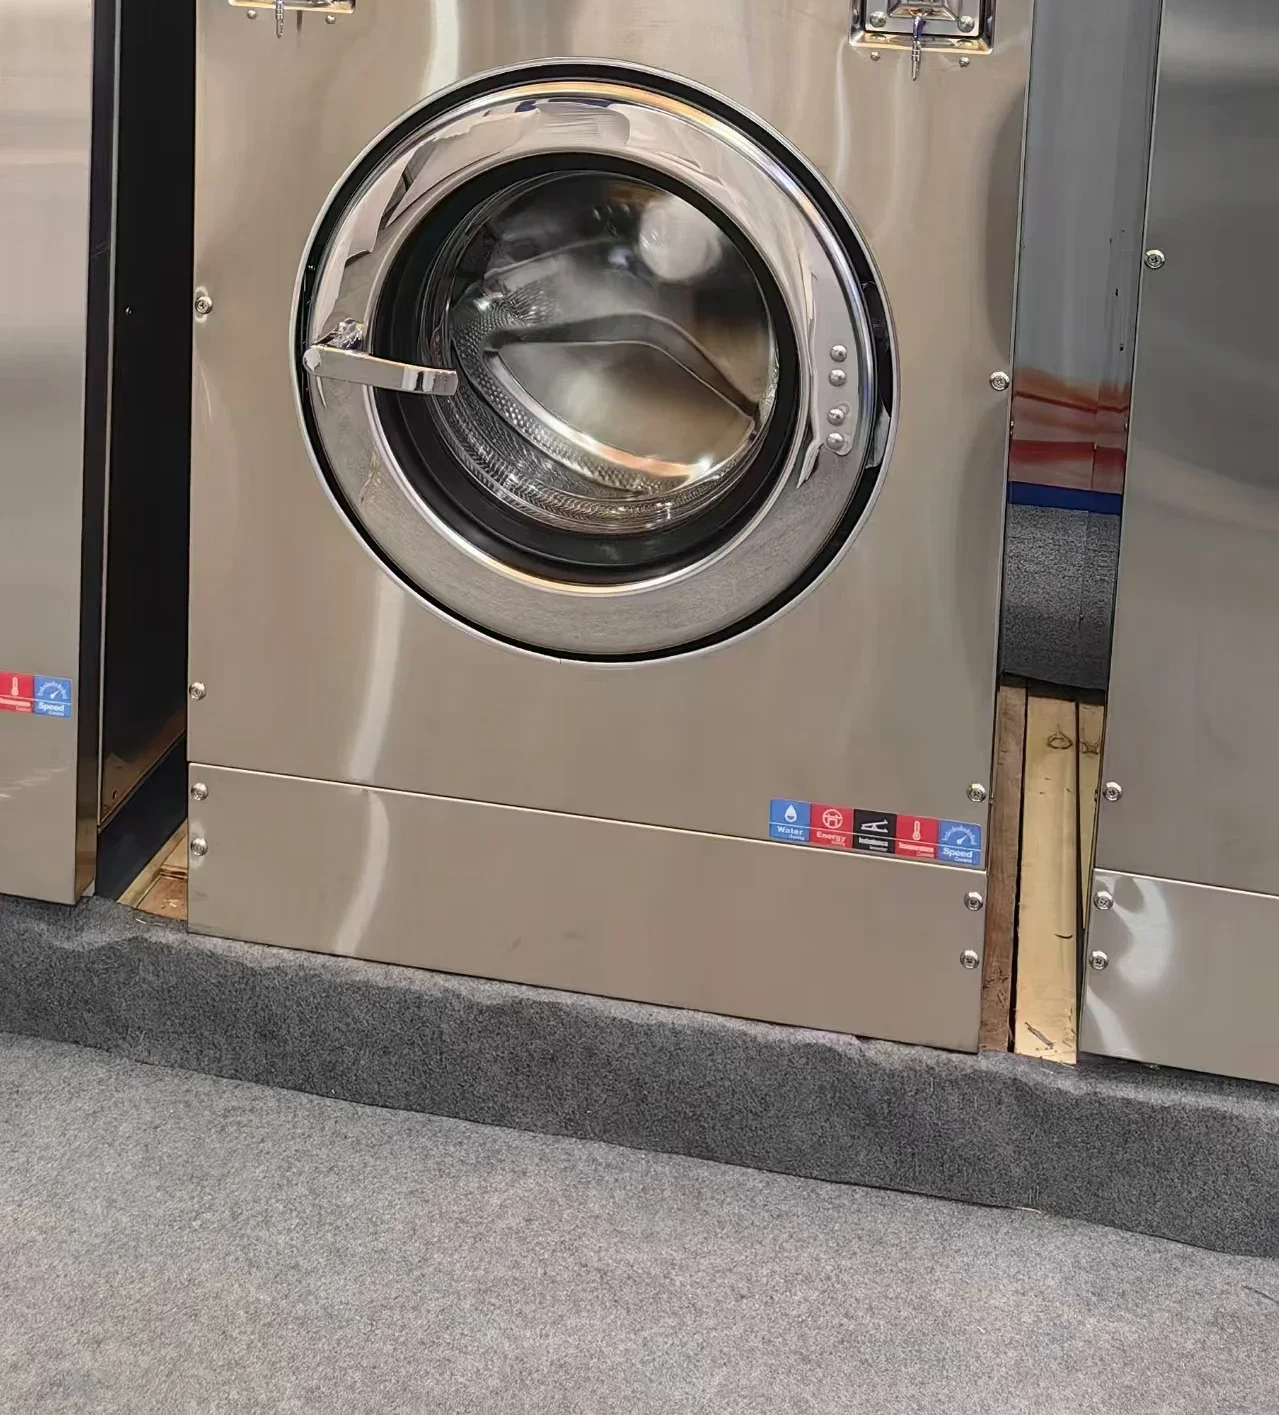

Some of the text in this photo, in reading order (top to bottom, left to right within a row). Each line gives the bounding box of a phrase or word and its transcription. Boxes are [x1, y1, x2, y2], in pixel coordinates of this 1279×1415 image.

[38, 701, 65, 712] Speed
[776, 825, 803, 836] Water
[816, 831, 847, 843] Energy
[943, 847, 973, 859] Speed
